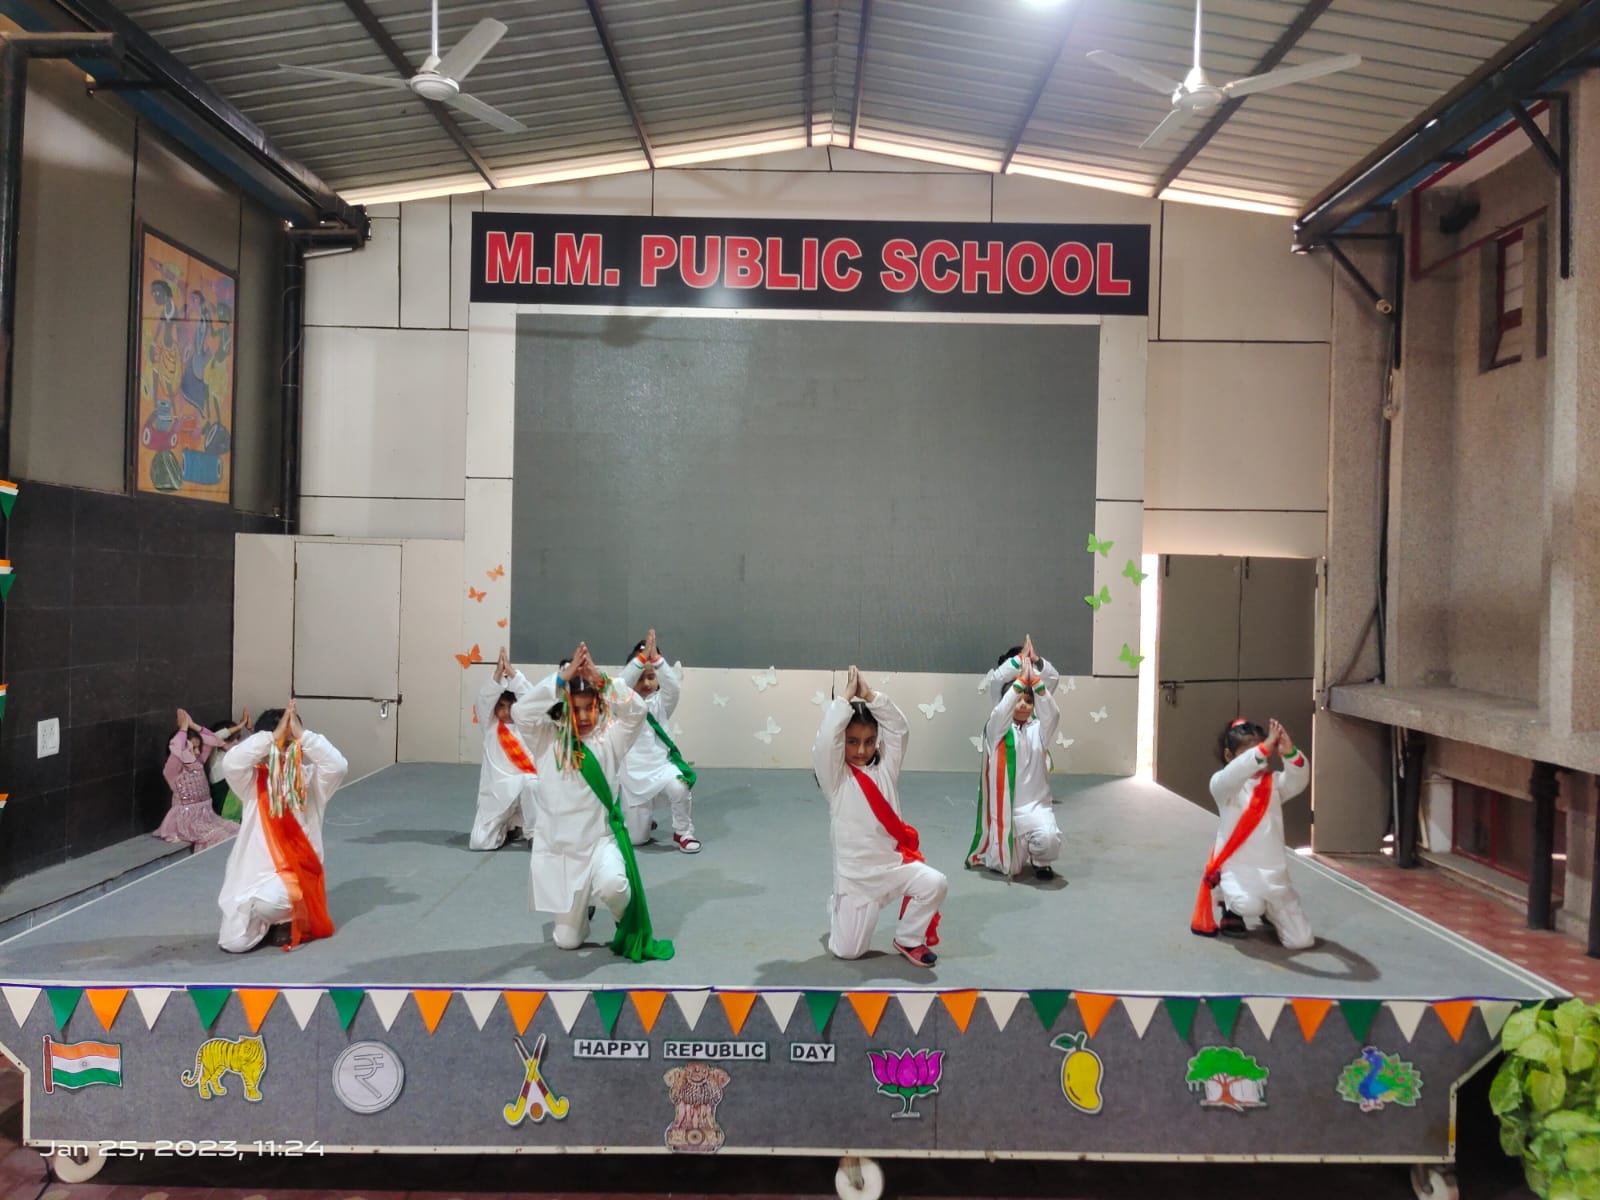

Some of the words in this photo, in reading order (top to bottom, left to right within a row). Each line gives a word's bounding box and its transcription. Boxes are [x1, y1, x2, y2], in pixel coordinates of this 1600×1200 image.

[485, 231, 620, 285] M.M.
[641, 235, 862, 291] PUBLIC
[881, 239, 1131, 295] SCHOOL
[578, 1041, 647, 1057] HAPPY
[666, 1043, 764, 1058] REPUBLIC
[793, 1044, 833, 1060] DAY
